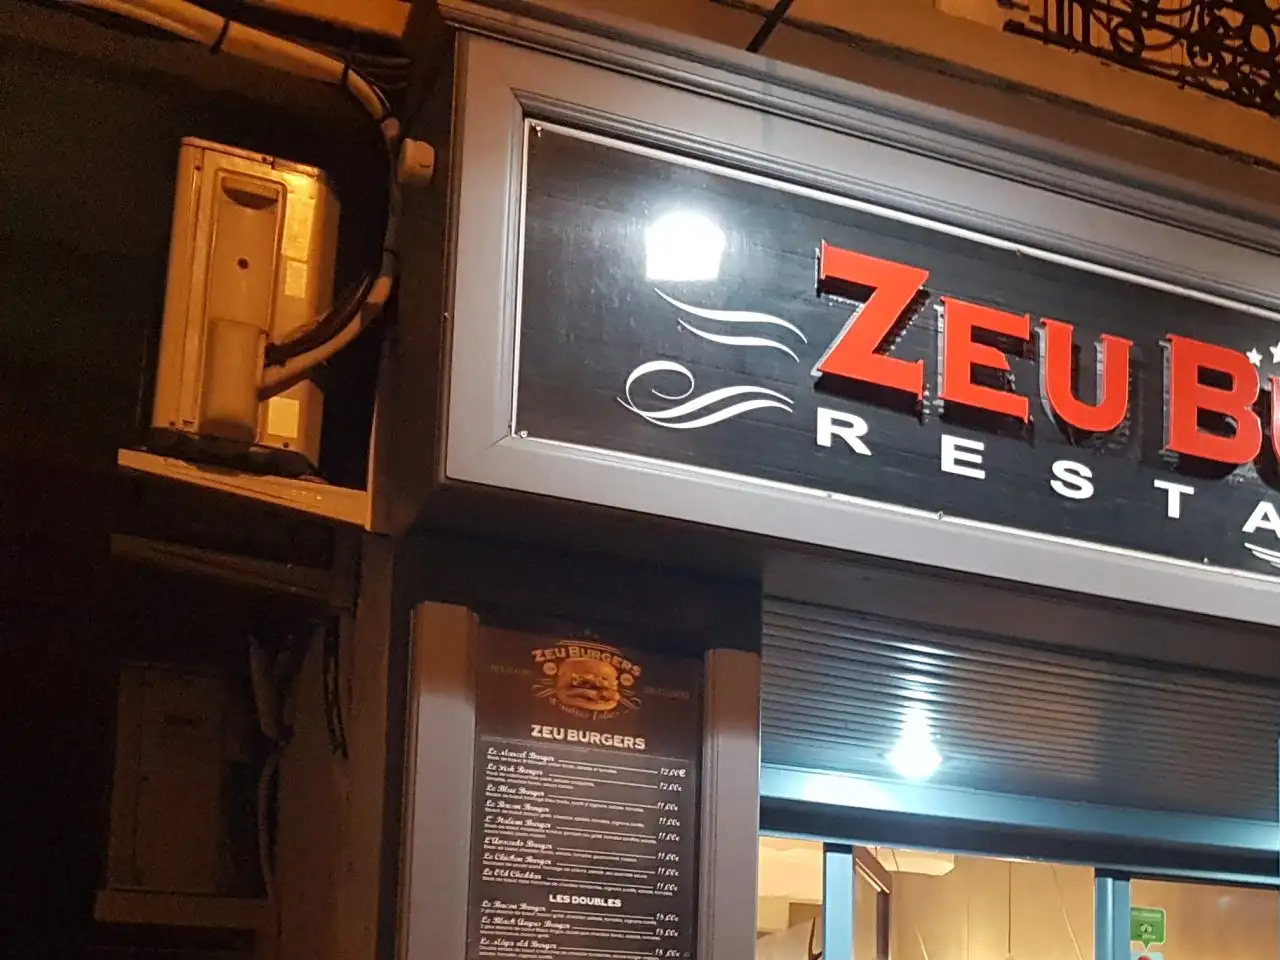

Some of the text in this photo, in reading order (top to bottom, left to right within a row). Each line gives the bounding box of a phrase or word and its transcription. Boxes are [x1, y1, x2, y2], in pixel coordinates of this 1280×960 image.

[815, 239, 1134, 433] ZEU
[532, 646, 642, 677] ZEU BURGERS
[531, 724, 646, 750] ZEU BURGERS
[549, 894, 622, 907] LES DOUBLES
